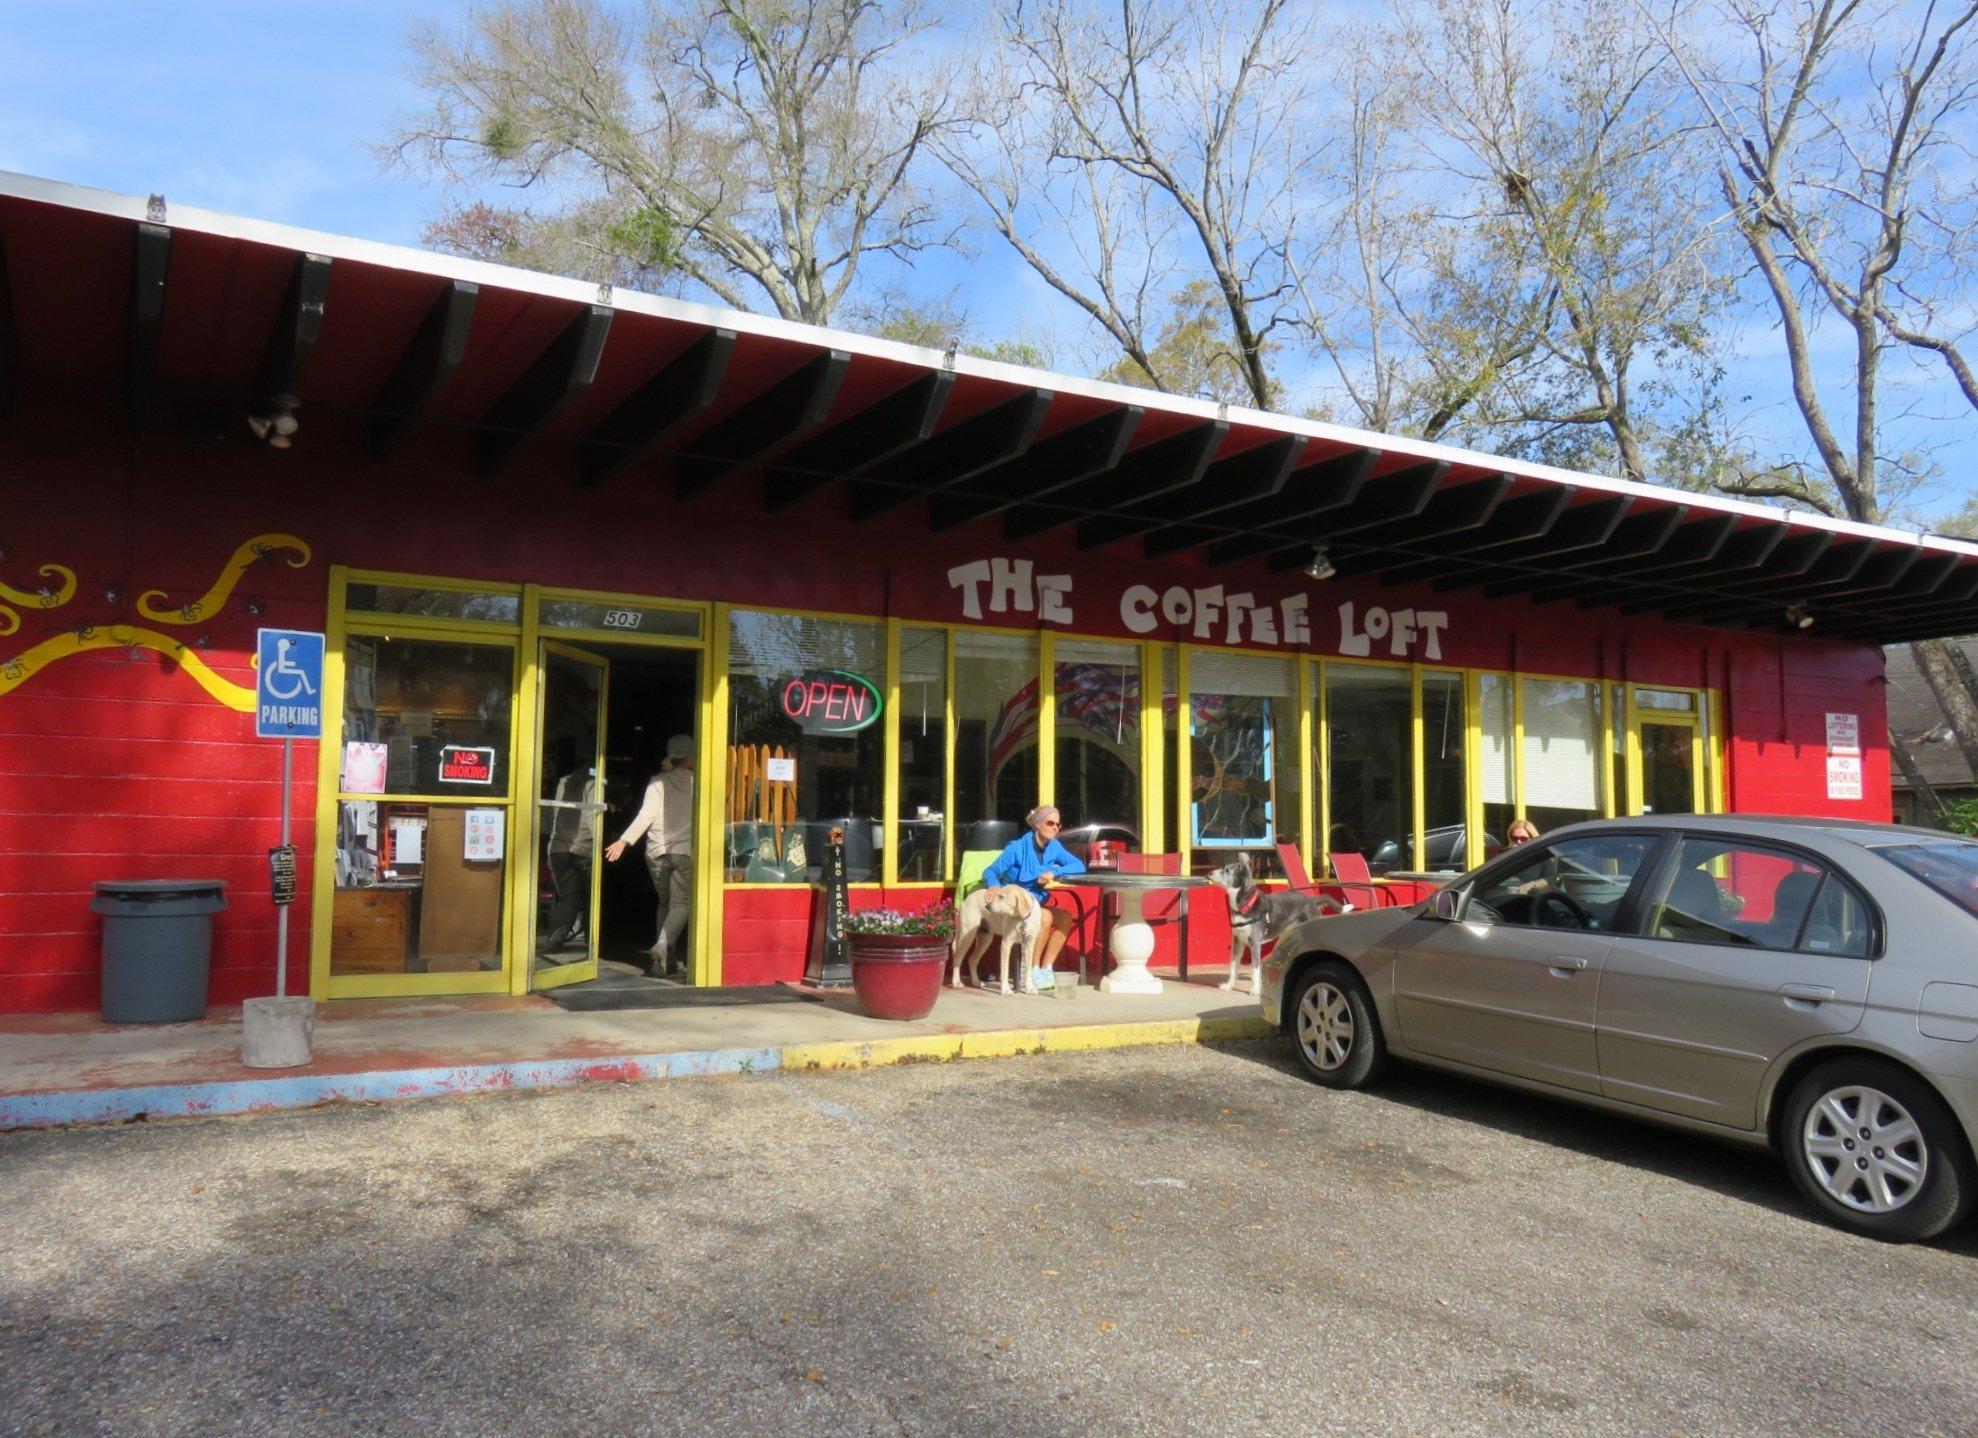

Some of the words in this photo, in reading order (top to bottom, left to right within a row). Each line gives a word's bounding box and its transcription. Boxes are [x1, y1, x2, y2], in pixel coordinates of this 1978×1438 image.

[948, 558, 1073, 625] THE
[1120, 584, 1311, 646] COFFEE
[1338, 601, 1449, 661] LOFT
[606, 611, 639, 627] 503
[784, 680, 867, 721] OPEN
[262, 705, 318, 726] PARKING
[454, 752, 479, 765] NO
[1839, 761, 1849, 769] NO
[444, 765, 487, 779] SMOKING
[835, 861, 842, 877] NO
